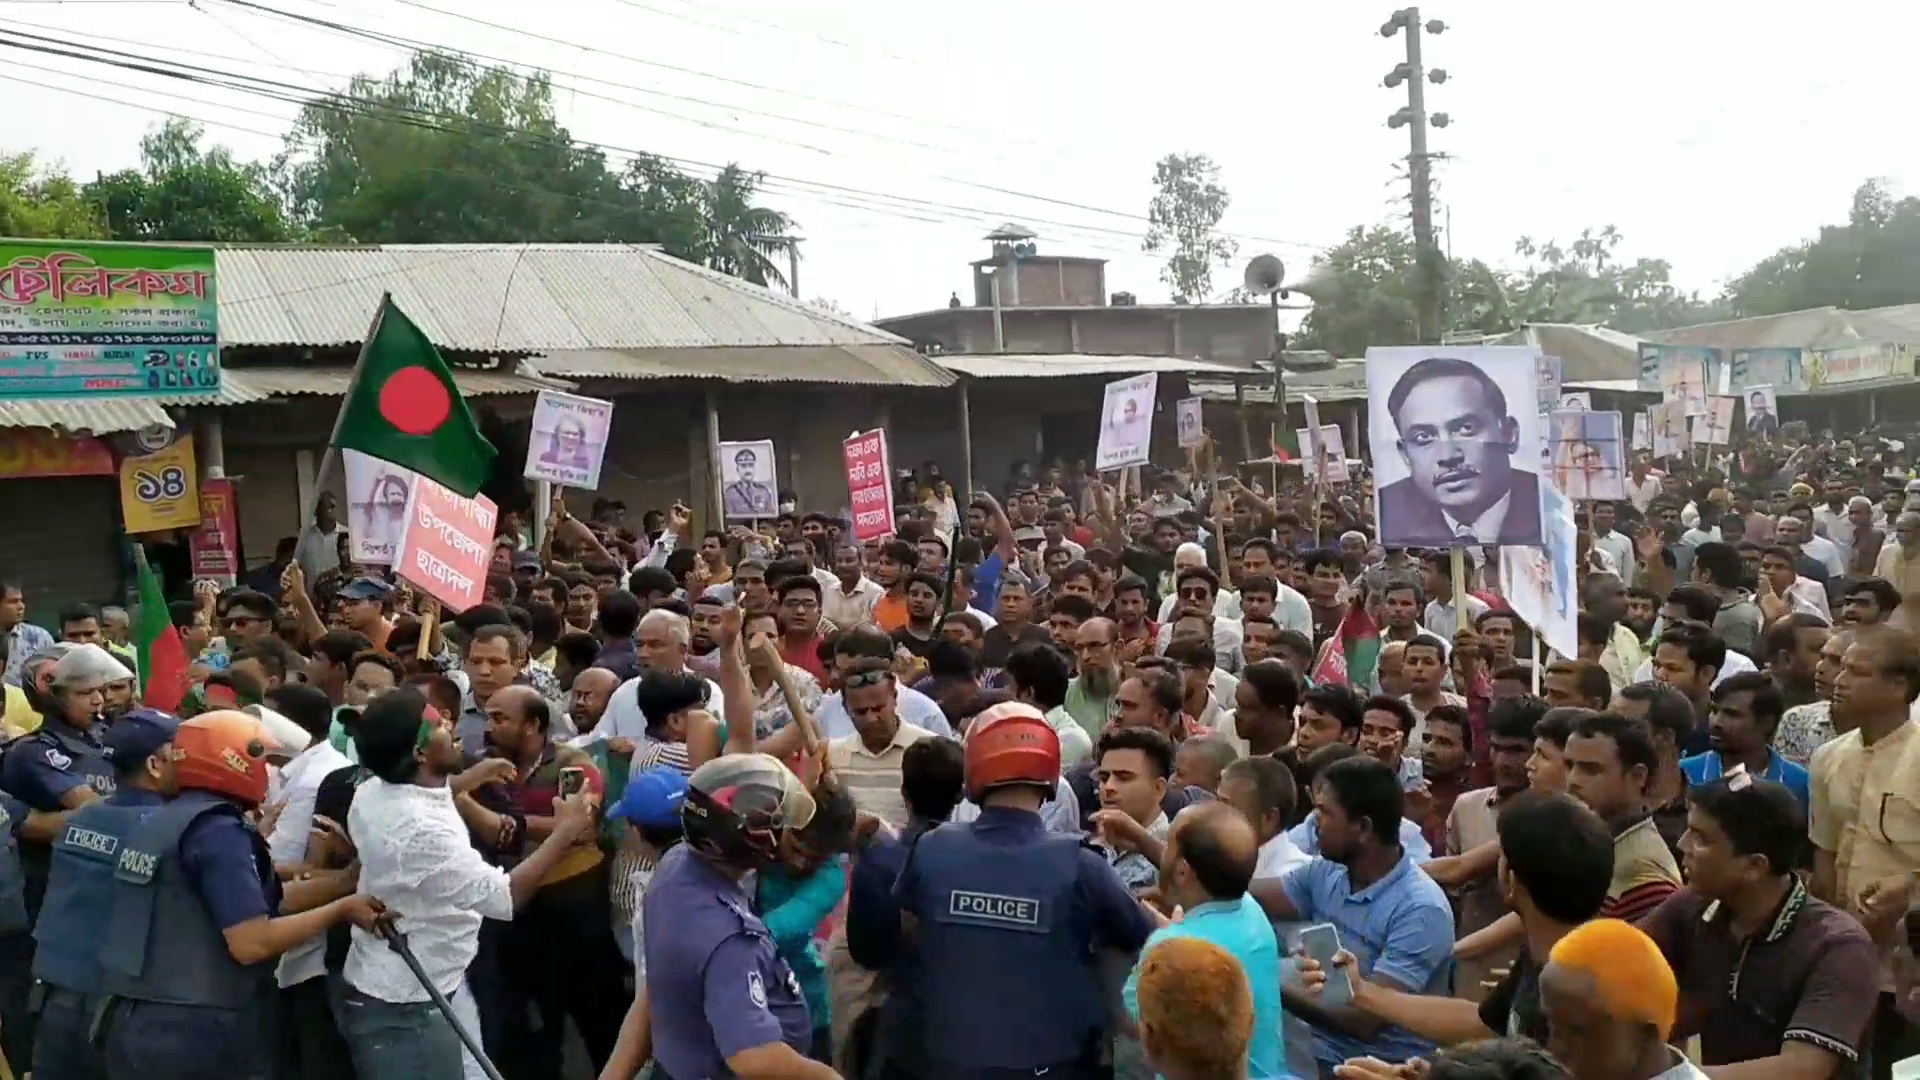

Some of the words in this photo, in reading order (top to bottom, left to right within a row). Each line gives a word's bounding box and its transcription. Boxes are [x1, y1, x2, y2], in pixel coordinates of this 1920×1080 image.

[25, 351, 49, 360] TVS
[864, 438, 879, 456] এক
[849, 461, 866, 481] দাবি
[867, 460, 882, 479] এক
[417, 501, 487, 568] উপজেলা
[416, 547, 474, 599] ছাত্রদল
[73, 829, 109, 850] POLICE
[118, 848, 157, 877] POLICE
[959, 896, 1029, 918] POLICE
